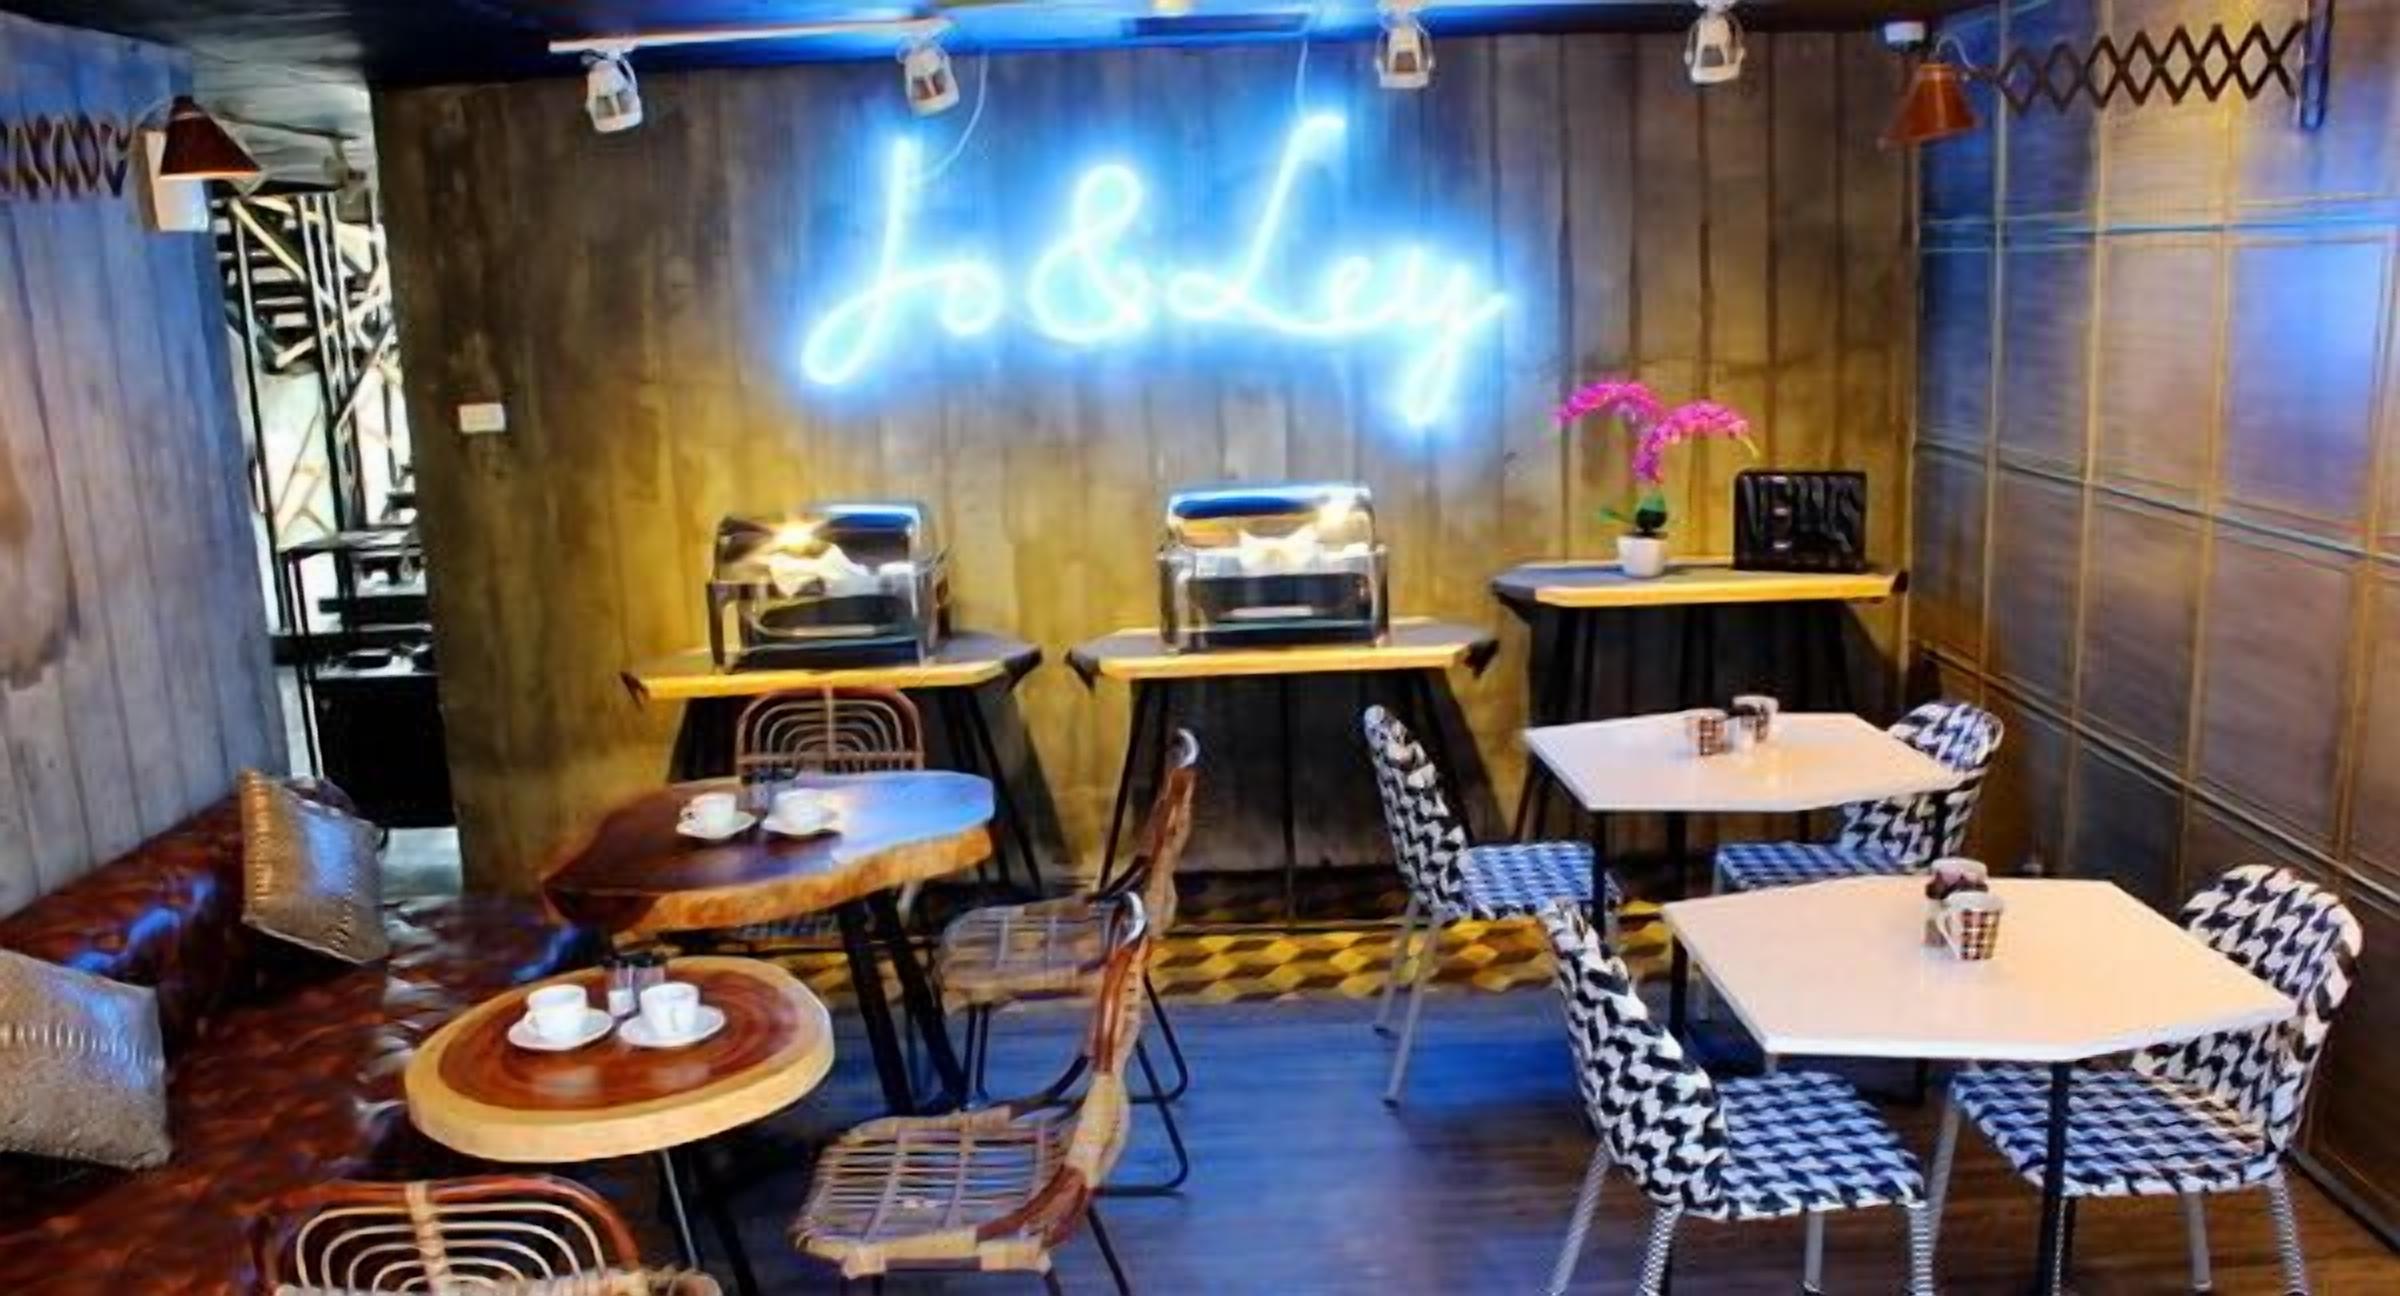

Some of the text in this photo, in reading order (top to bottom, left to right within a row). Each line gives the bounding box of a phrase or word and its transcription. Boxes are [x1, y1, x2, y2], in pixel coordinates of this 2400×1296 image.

[803, 113, 1513, 428] Jo & Ley
